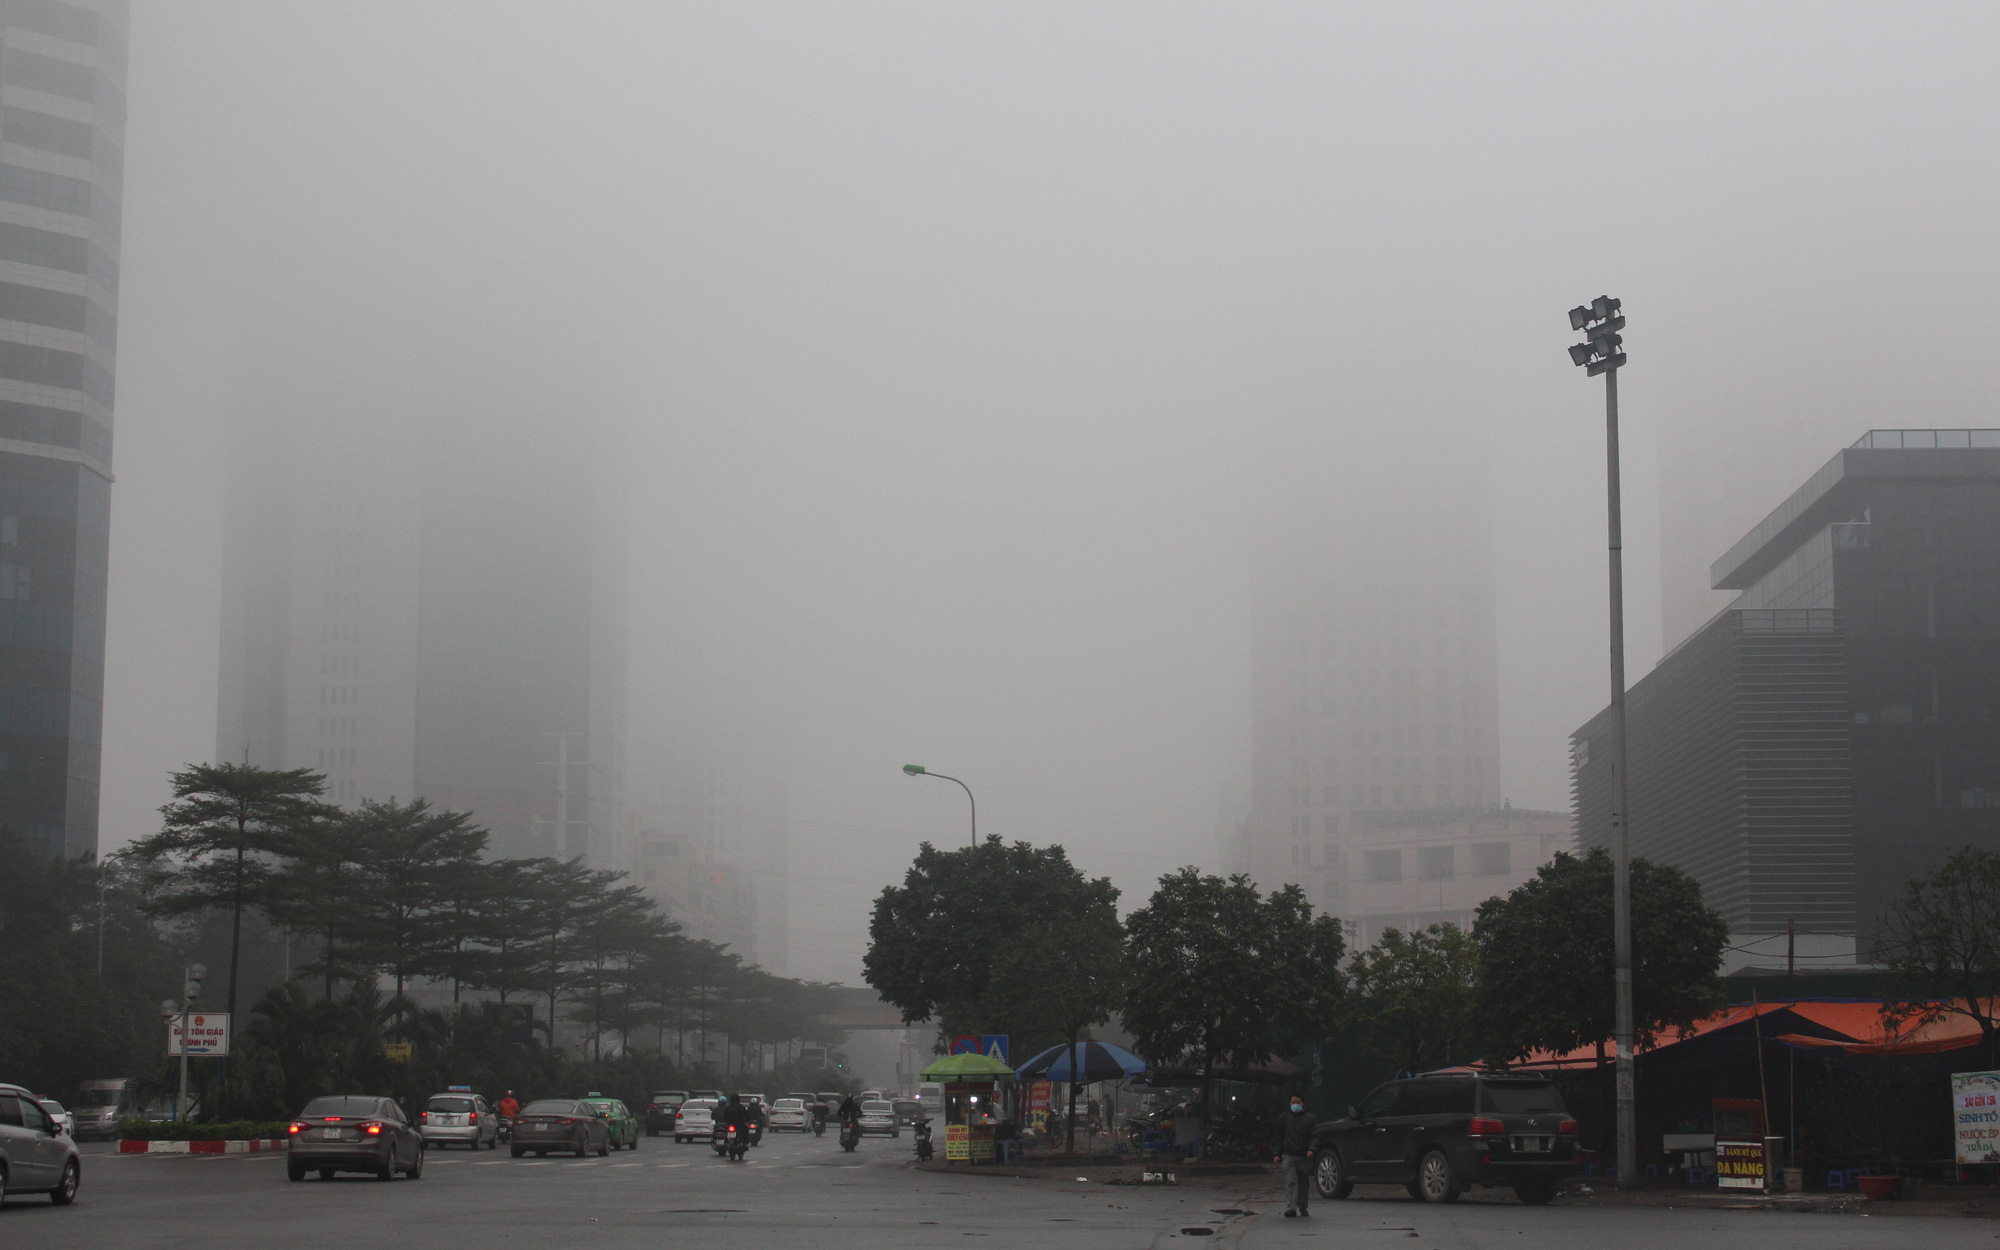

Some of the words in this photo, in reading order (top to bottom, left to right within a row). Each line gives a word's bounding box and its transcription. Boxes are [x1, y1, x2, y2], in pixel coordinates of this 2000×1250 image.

[191, 1027, 205, 1036] TÔN
[206, 1027, 224, 1036] GIÁO
[202, 1037, 218, 1046] PHỦ
[1959, 1113, 1983, 1123] SINH
[1984, 1109, 1999, 1122] TỐ
